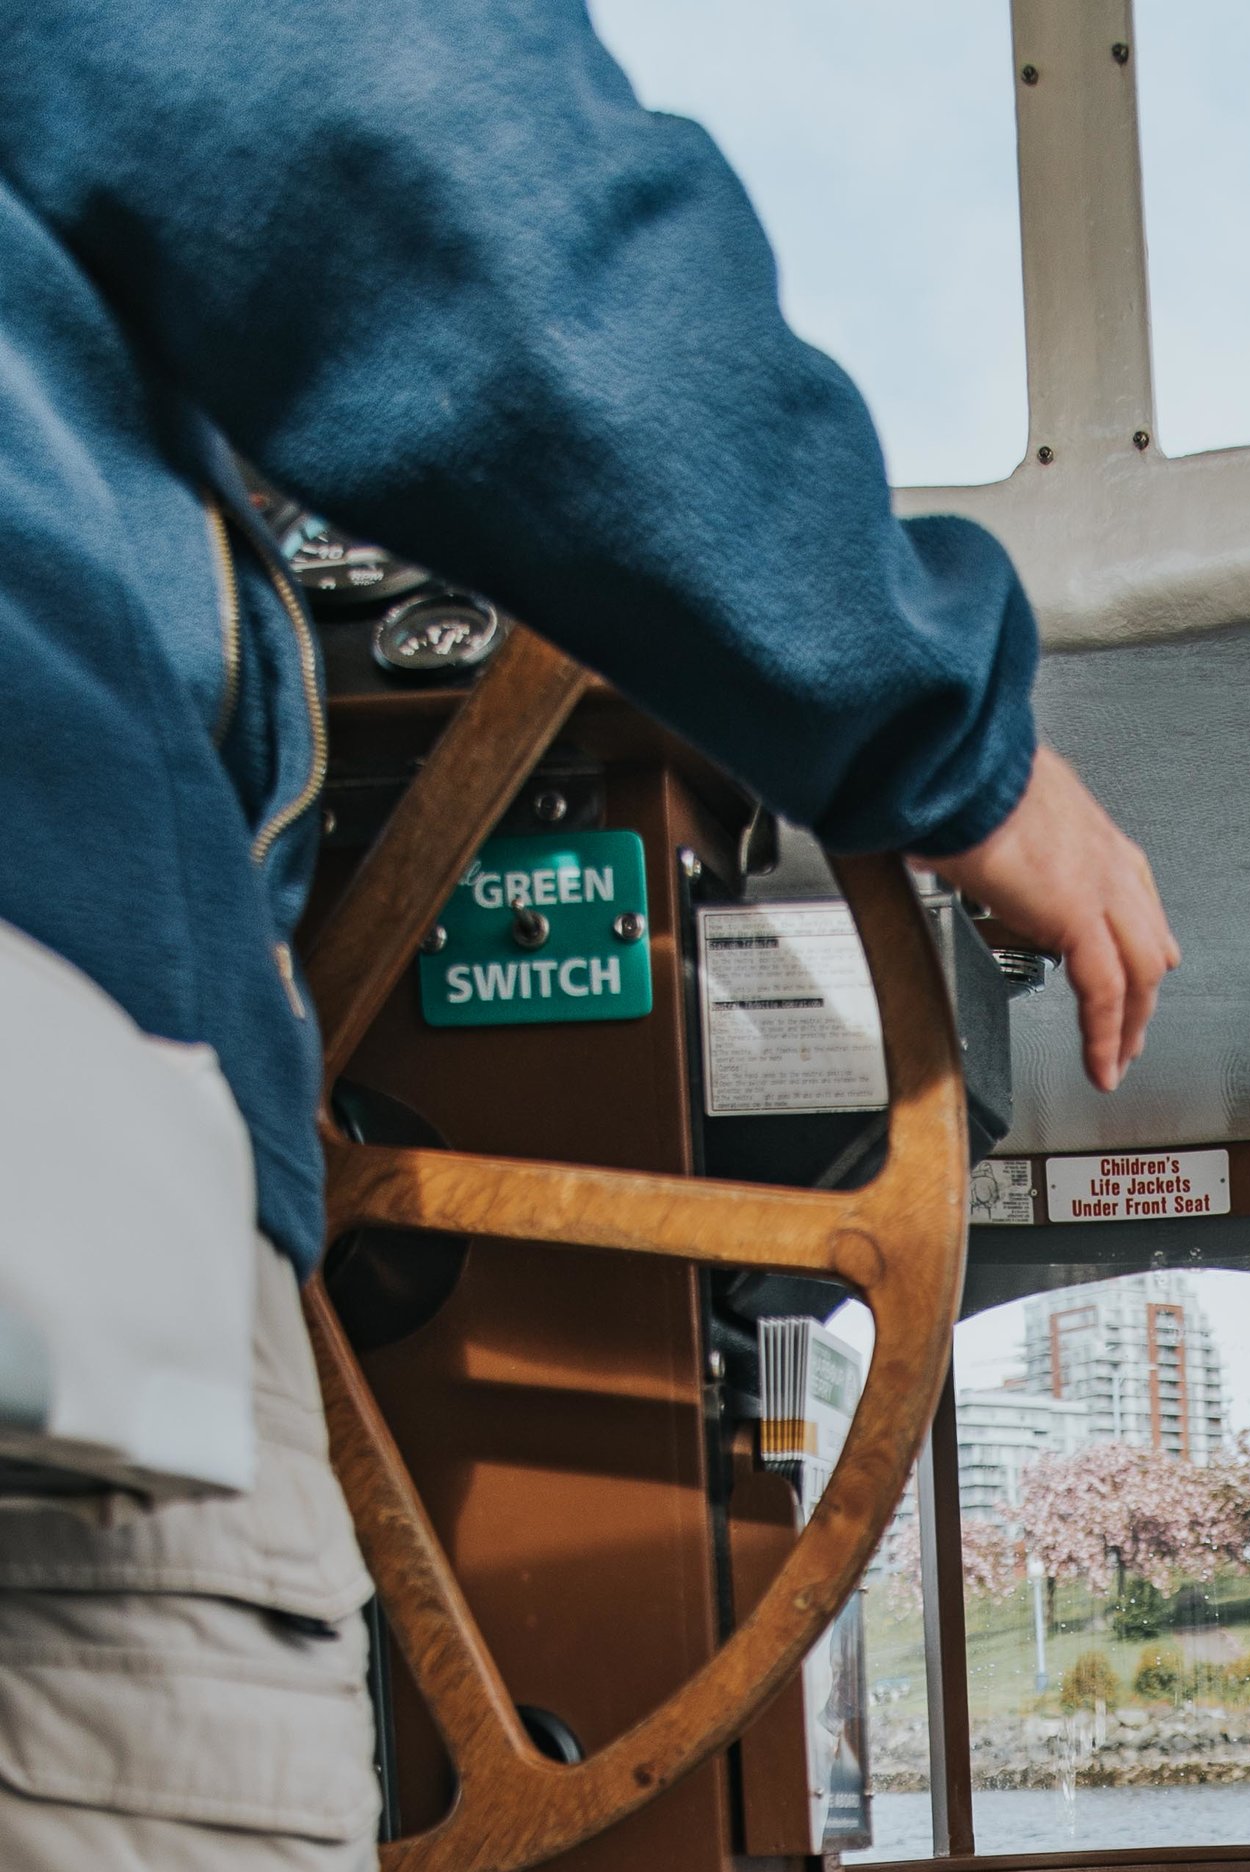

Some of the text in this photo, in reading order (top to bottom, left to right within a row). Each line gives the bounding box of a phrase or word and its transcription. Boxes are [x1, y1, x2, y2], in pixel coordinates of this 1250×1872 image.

[473, 865, 615, 910] GREEN
[446, 956, 622, 1004] SWITCH
[1100, 1155, 1180, 1177] Children's
[1090, 1176, 1191, 1197] Life Jackets
[1071, 1193, 1211, 1218] Under Front Seat
